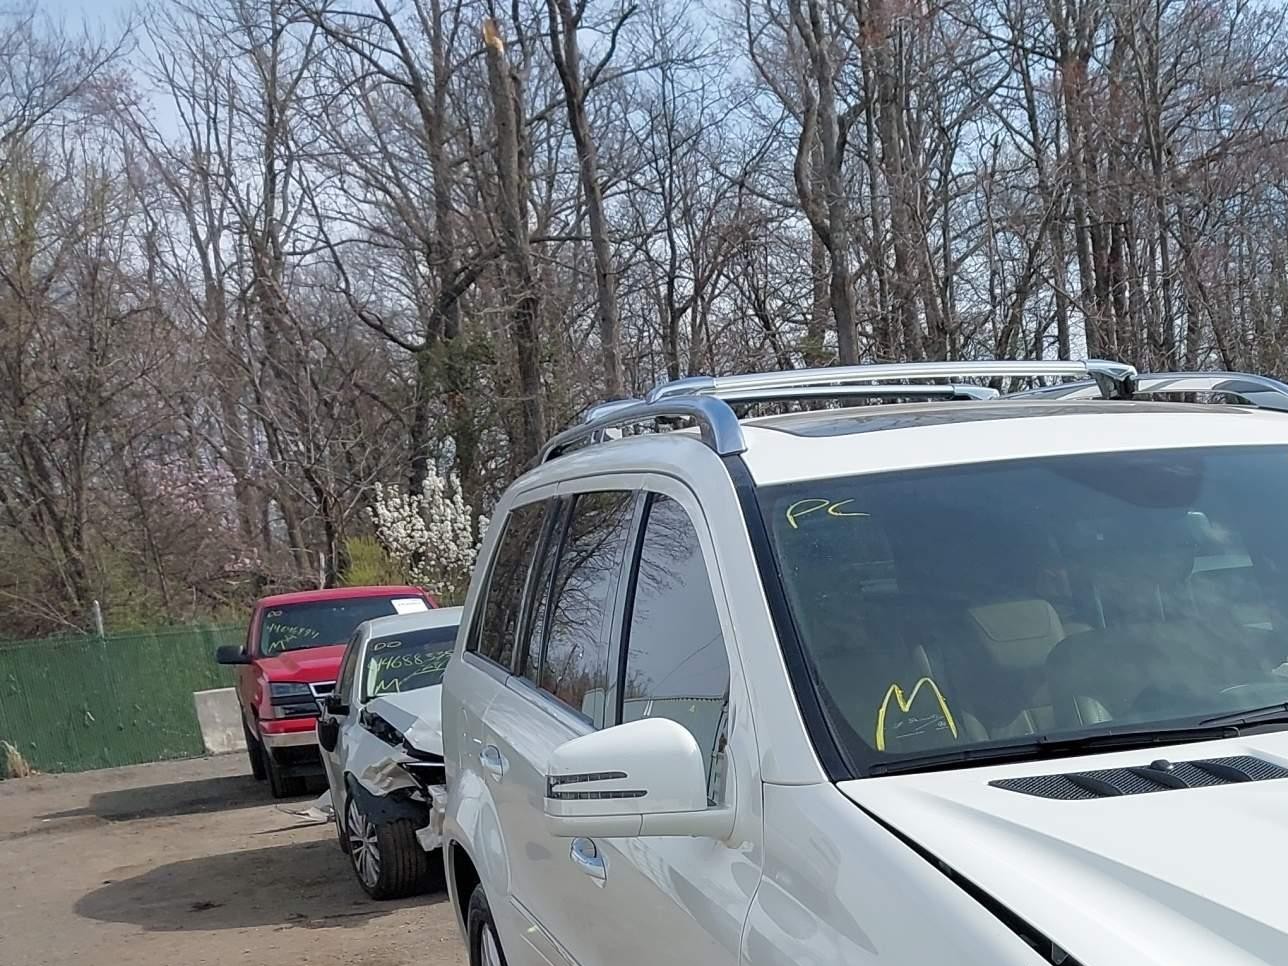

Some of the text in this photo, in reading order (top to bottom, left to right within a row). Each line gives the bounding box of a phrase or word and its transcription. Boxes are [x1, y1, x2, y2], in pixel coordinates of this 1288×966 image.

[786, 499, 872, 529] PC
[374, 678, 401, 696] M
[876, 677, 959, 752] M
